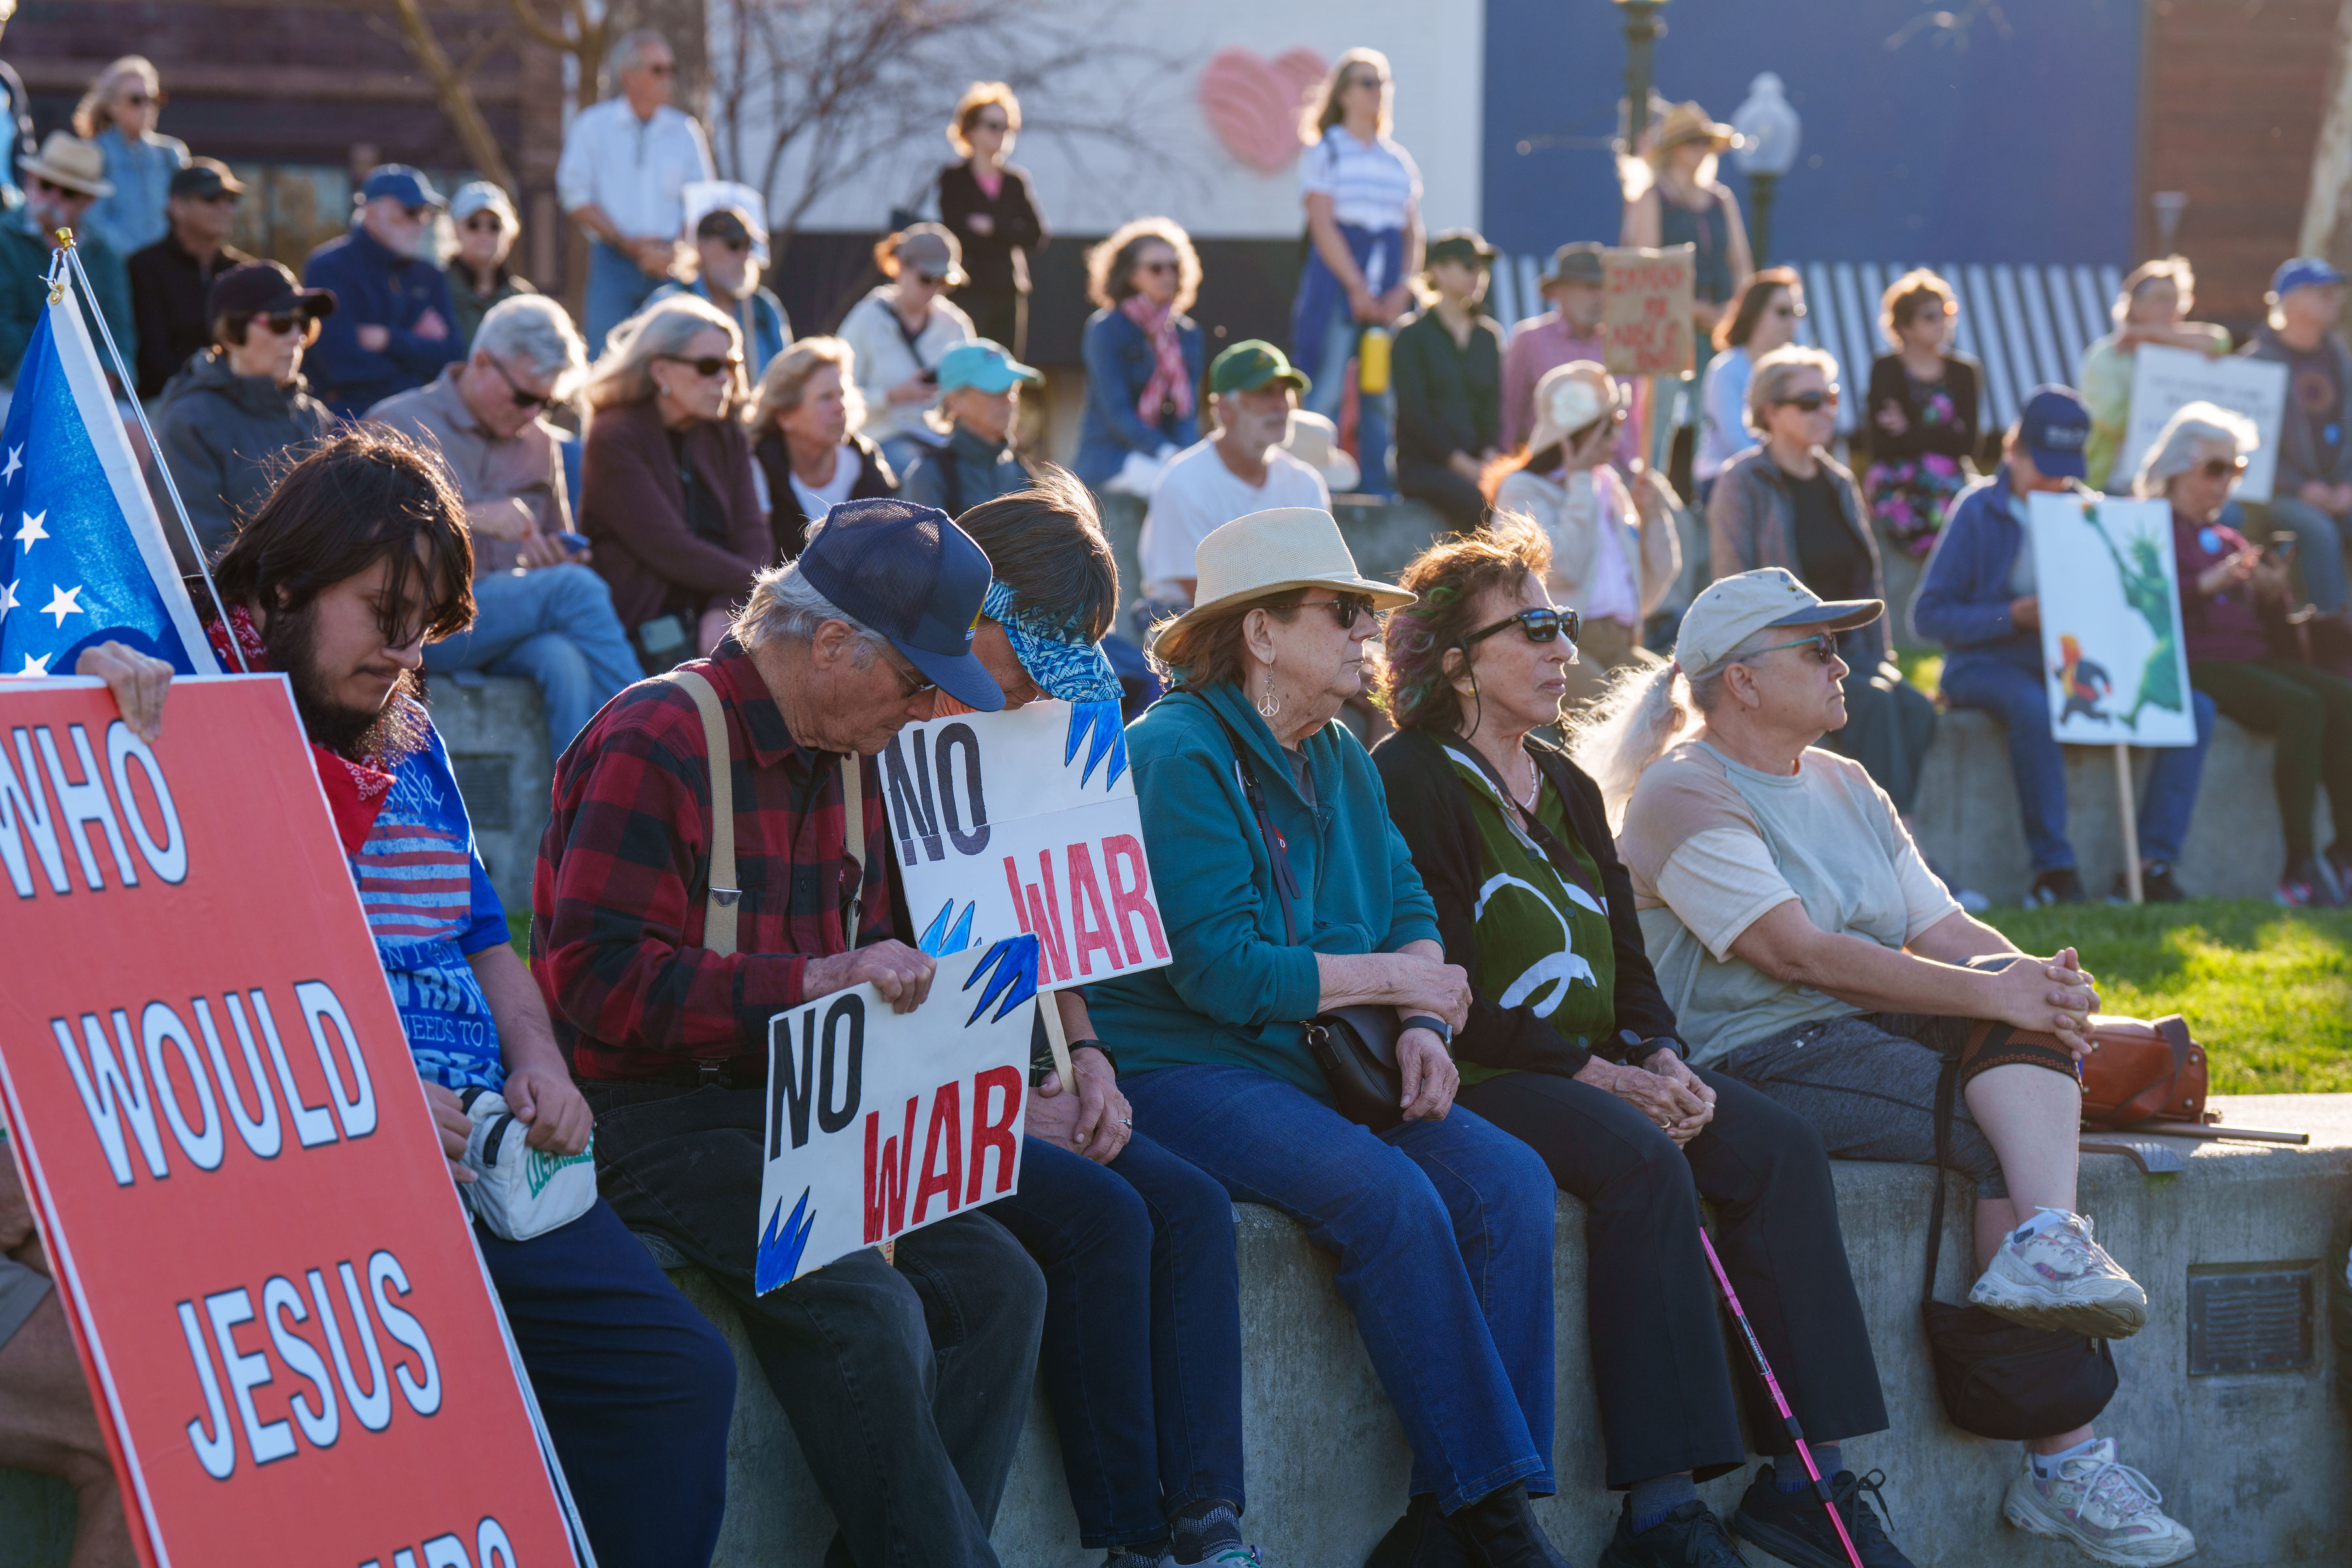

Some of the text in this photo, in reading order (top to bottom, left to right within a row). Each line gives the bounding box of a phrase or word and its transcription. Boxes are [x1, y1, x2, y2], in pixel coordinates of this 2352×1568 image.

[0, 717, 188, 900] WHO
[885, 722, 990, 866] NO
[1003, 834, 1170, 985] WAR
[52, 979, 378, 1187] WOULD
[459, 1021, 484, 1047] TO
[770, 993, 865, 1162] NO
[863, 1064, 1022, 1245] WAR
[175, 1250, 442, 1481] JESUS
